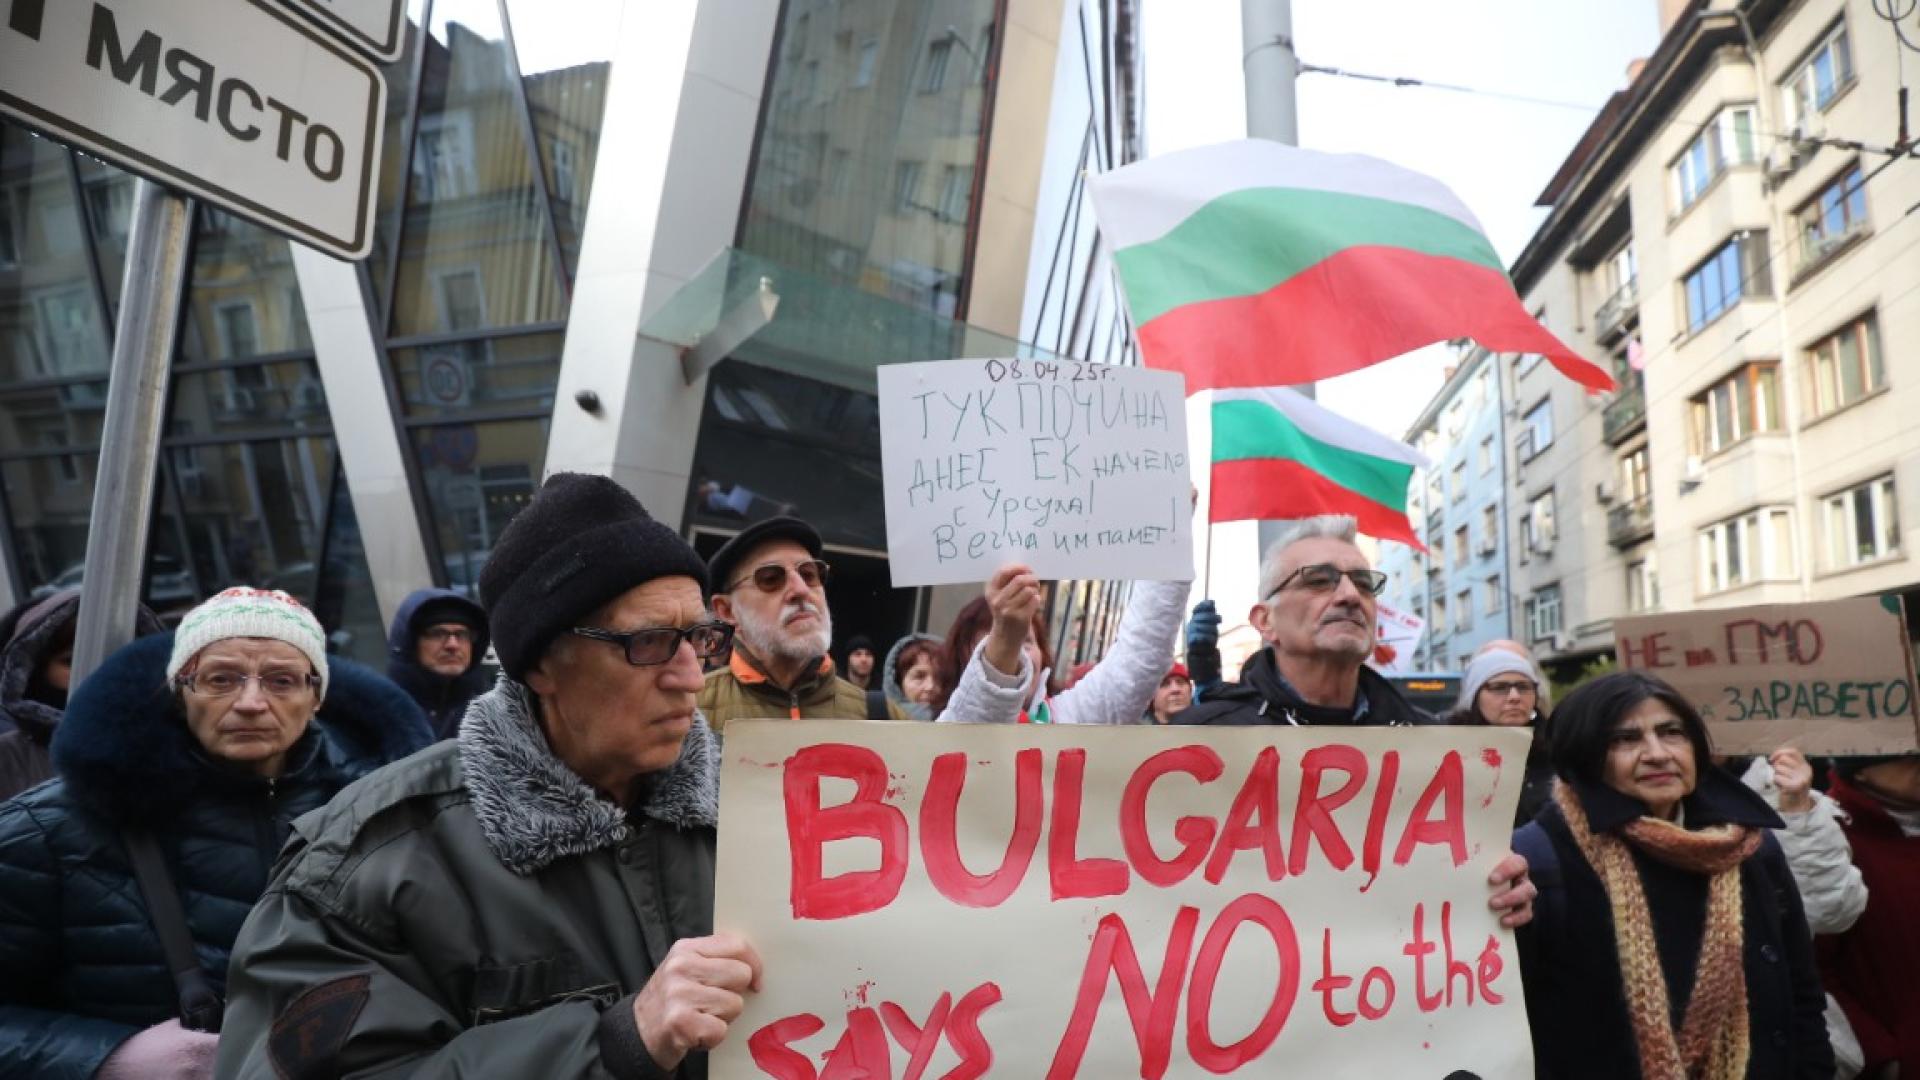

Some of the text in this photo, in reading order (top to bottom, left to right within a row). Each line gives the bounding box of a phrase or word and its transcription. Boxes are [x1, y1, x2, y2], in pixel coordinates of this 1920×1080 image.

[85, 2, 345, 183] МЯСТО
[911, 382, 1169, 442] ТУК ПОЧИНА
[907, 447, 999, 507] ДНЕС
[1030, 437, 1082, 484] ЕК
[1621, 631, 1676, 670] НЕ
[1723, 618, 1825, 666] ГМО
[1722, 679, 1910, 722] ЗДРАВЕТО
[782, 742, 1469, 921] BULGARIA
[1045, 892, 1301, 1080] NO
[1311, 927, 1396, 1027] to
[1403, 900, 1504, 1013] the
